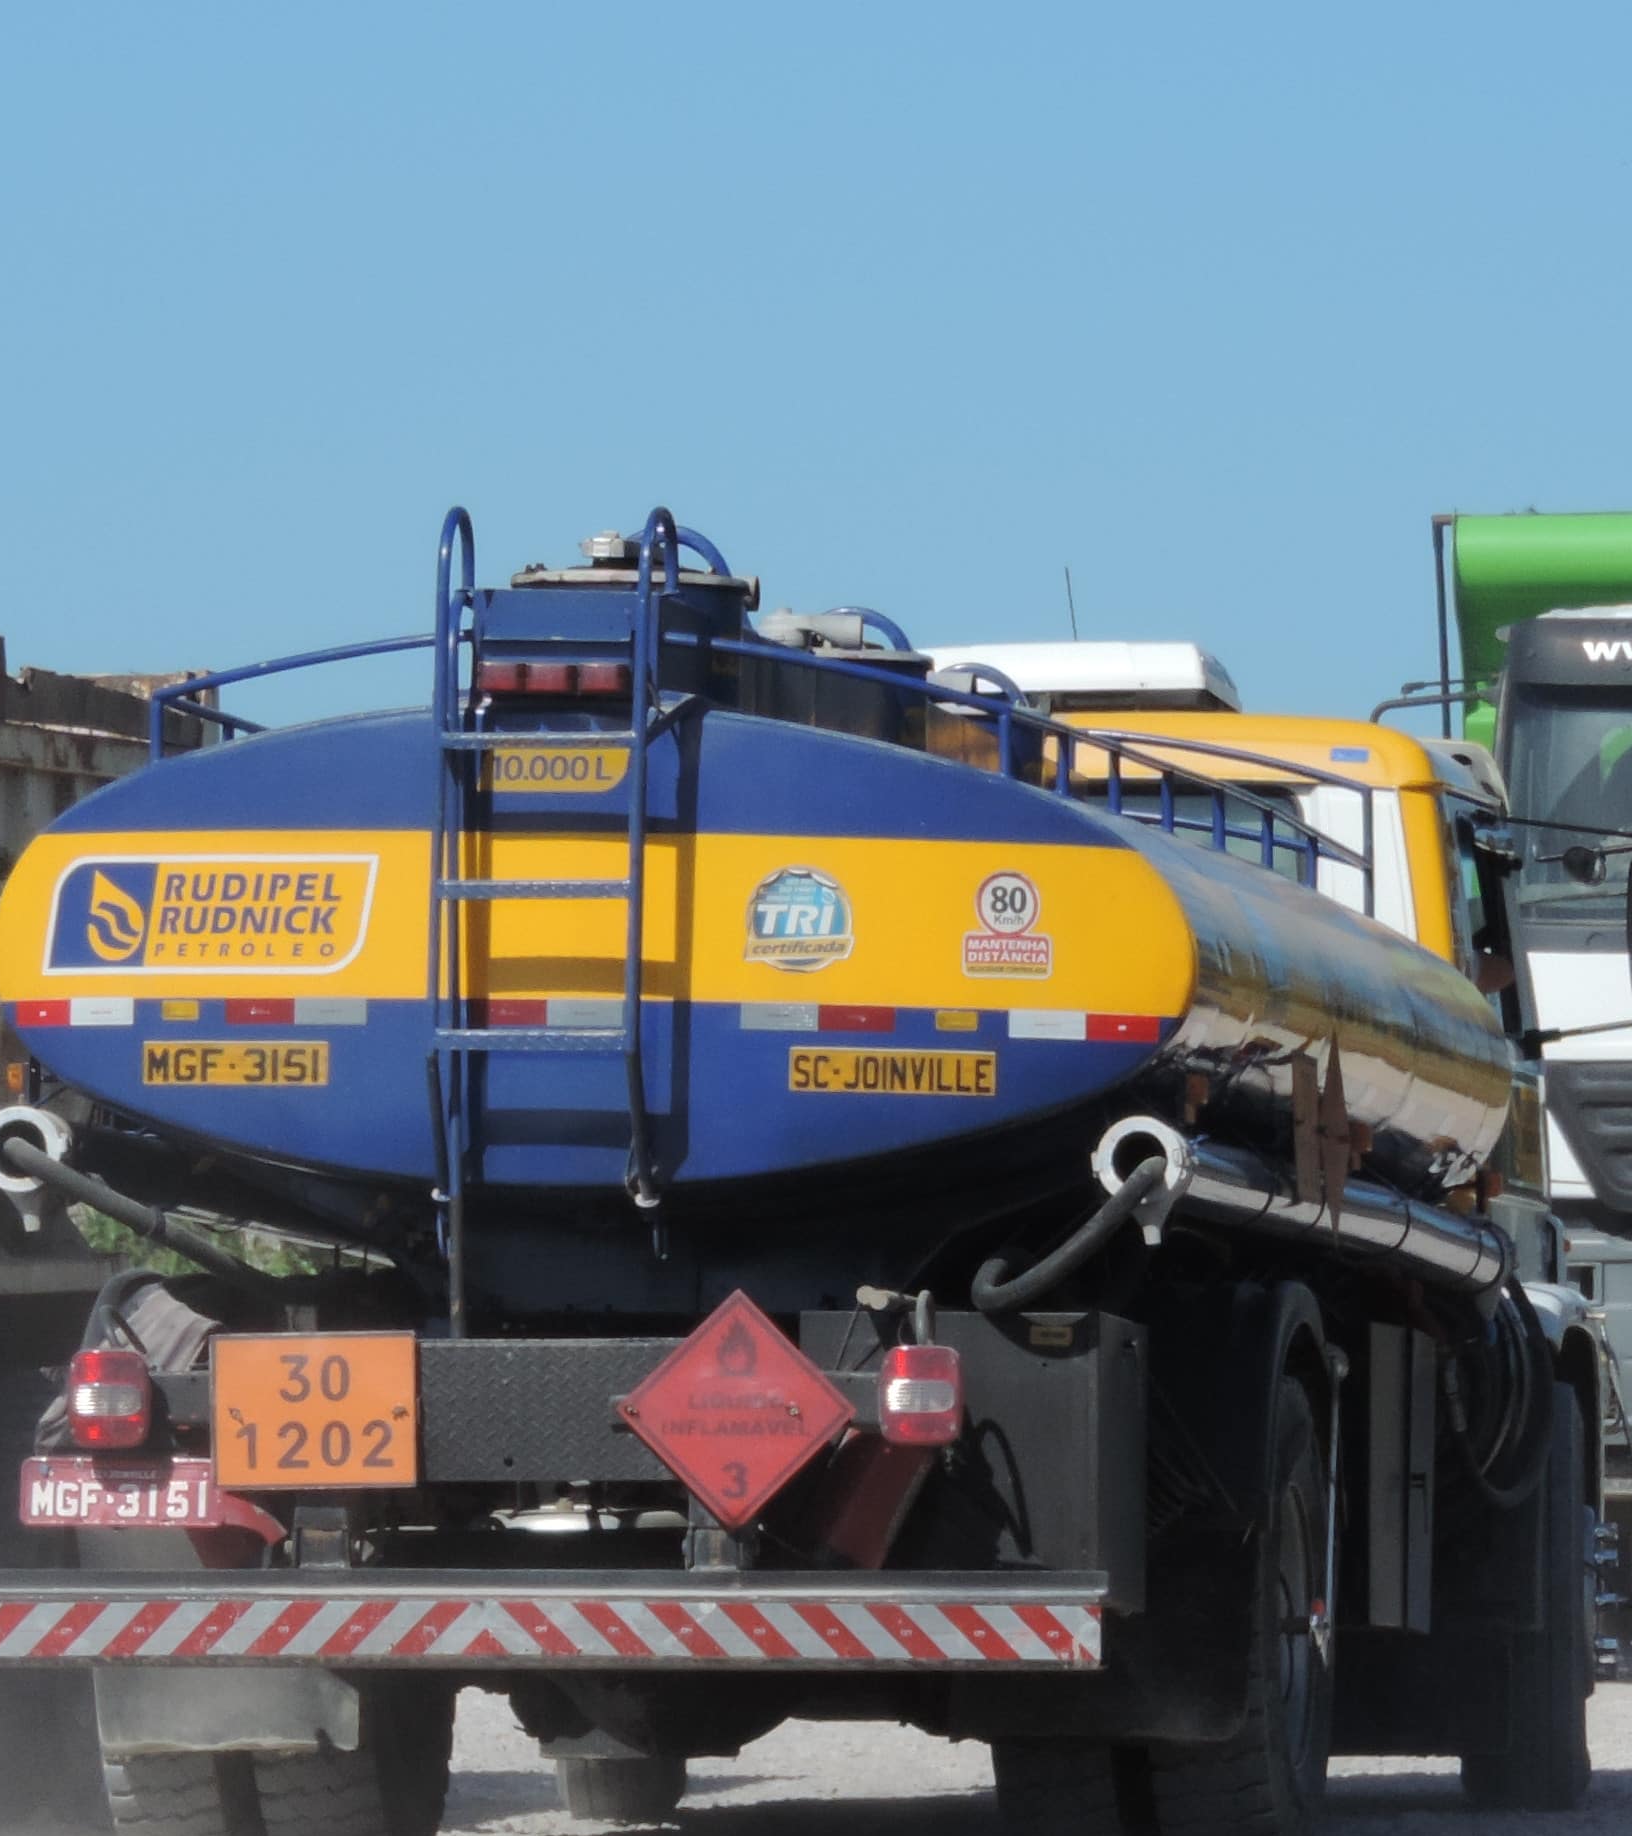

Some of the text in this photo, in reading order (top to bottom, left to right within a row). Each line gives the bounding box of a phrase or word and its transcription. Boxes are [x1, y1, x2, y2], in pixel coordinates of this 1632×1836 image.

[494, 755, 613, 781] 10.000 L
[163, 873, 342, 902] RUDIPEL
[990, 886, 1027, 914] 80
[158, 906, 338, 935] RUDNICK
[757, 905, 835, 935] TRI
[752, 942, 846, 955] certificada
[968, 939, 1048, 952] MANTENHA
[968, 951, 1048, 963] DISTÂNCIA
[279, 1355, 351, 1403] 30
[236, 1420, 395, 1470] 1202
[721, 1462, 749, 1500] 3
